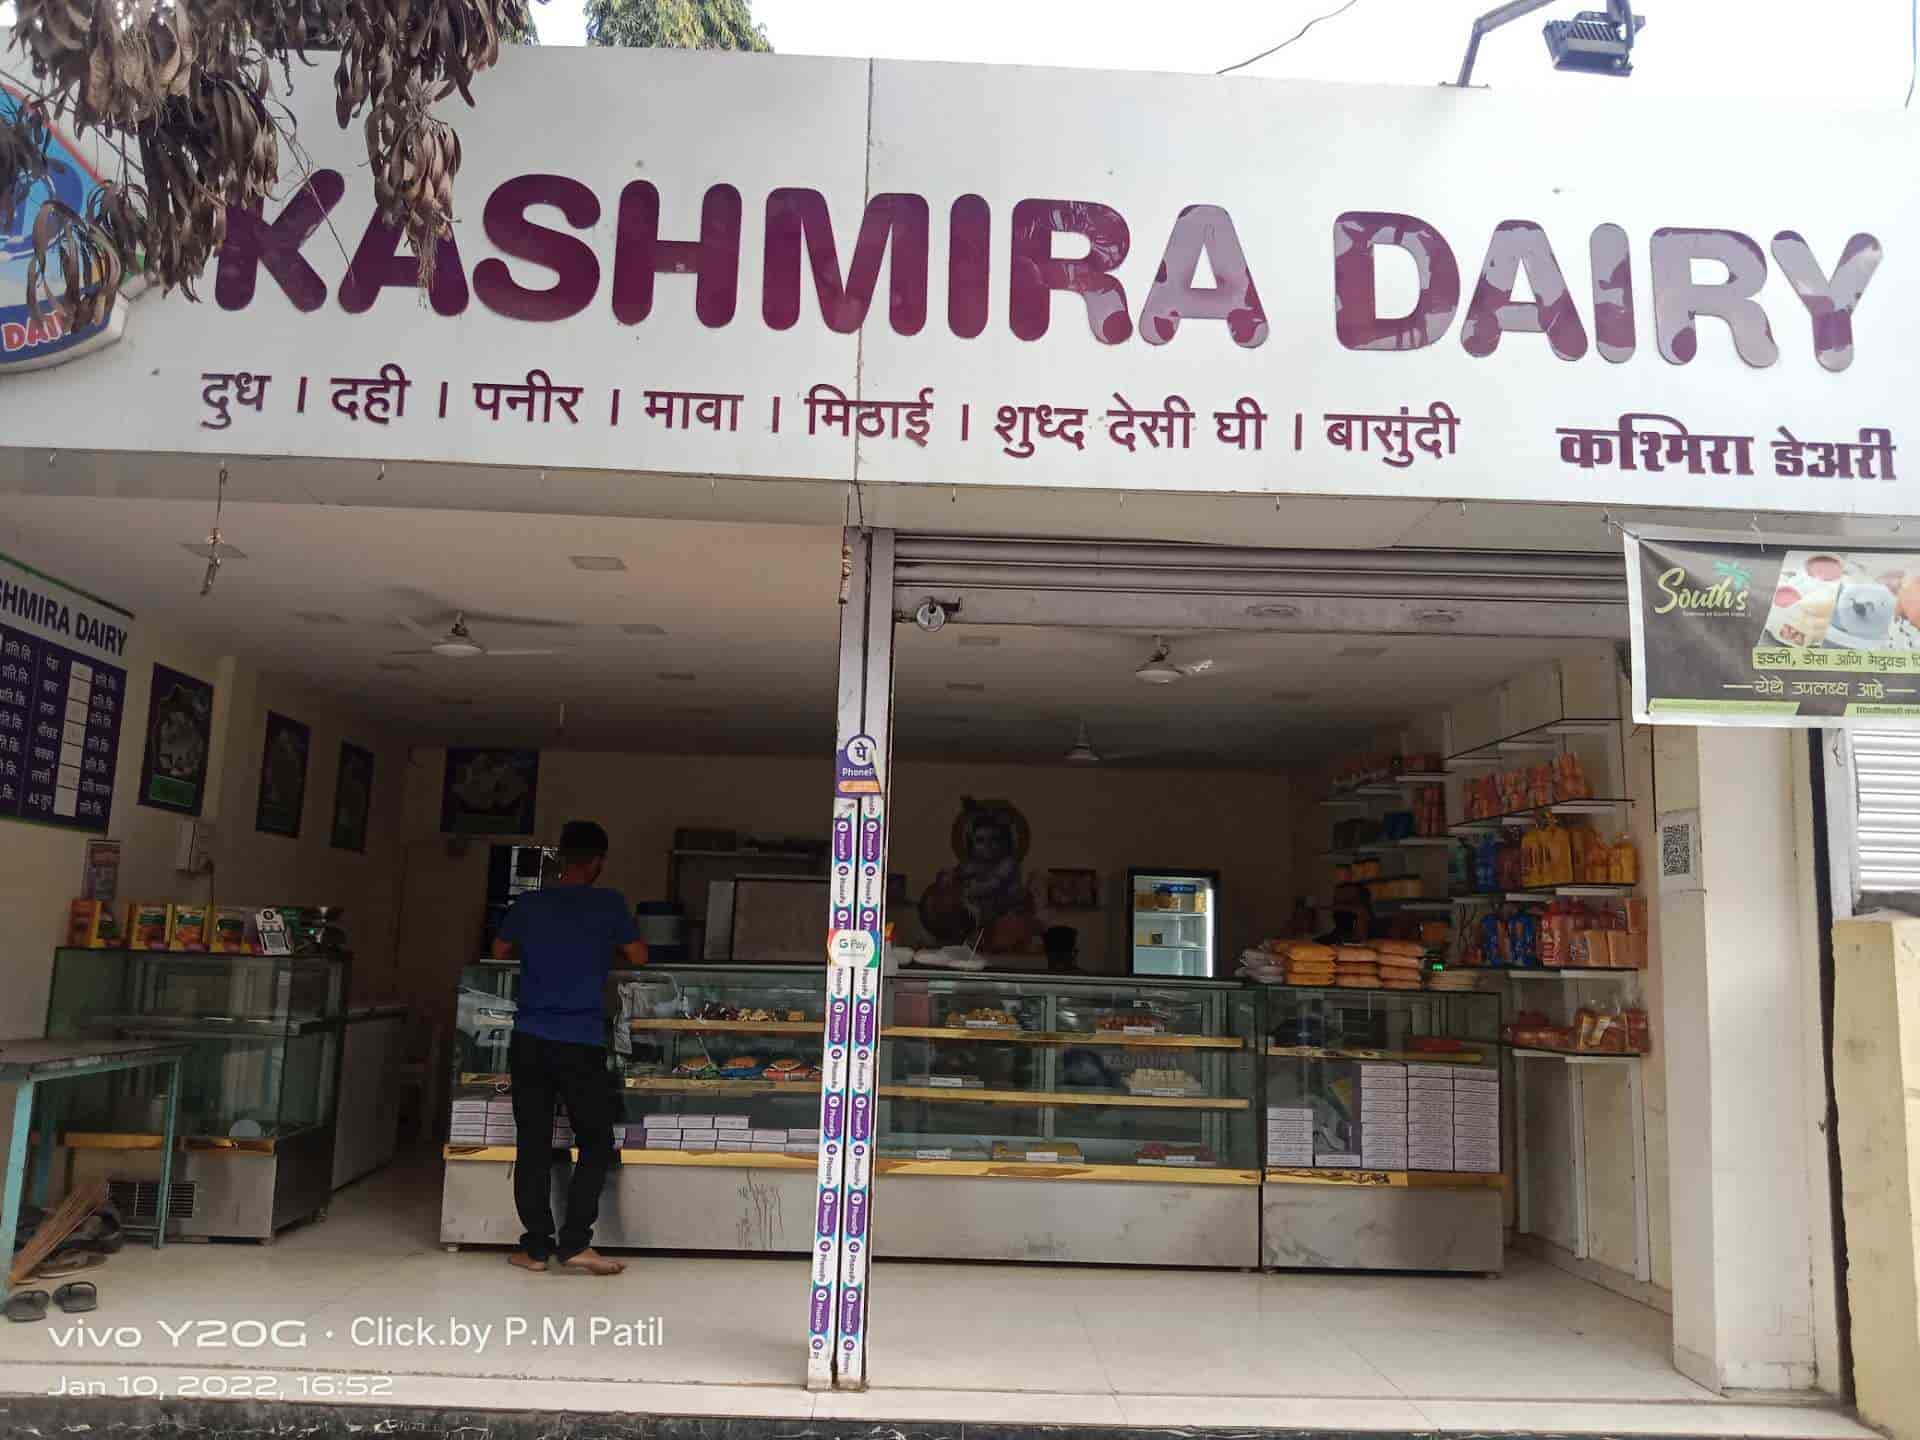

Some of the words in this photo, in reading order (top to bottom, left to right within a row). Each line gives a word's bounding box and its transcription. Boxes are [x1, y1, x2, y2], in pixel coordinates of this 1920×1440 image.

[216, 169, 1268, 348] KASHMIRA
[1333, 211, 1882, 372] DAIRY
[2, 310, 78, 352] DAI
[200, 371, 272, 430] दुध
[330, 363, 412, 425] दही
[472, 369, 584, 424] पनीर
[643, 390, 744, 431] मावा
[804, 383, 933, 447] मिठाई
[1107, 393, 1195, 452] देसी
[1213, 397, 1267, 450] घी
[1324, 401, 1460, 467] बासुंदी
[1771, 425, 1896, 481] डेअरी
[0, 579, 70, 635] HMIRA
[76, 611, 128, 657] DAIRY
